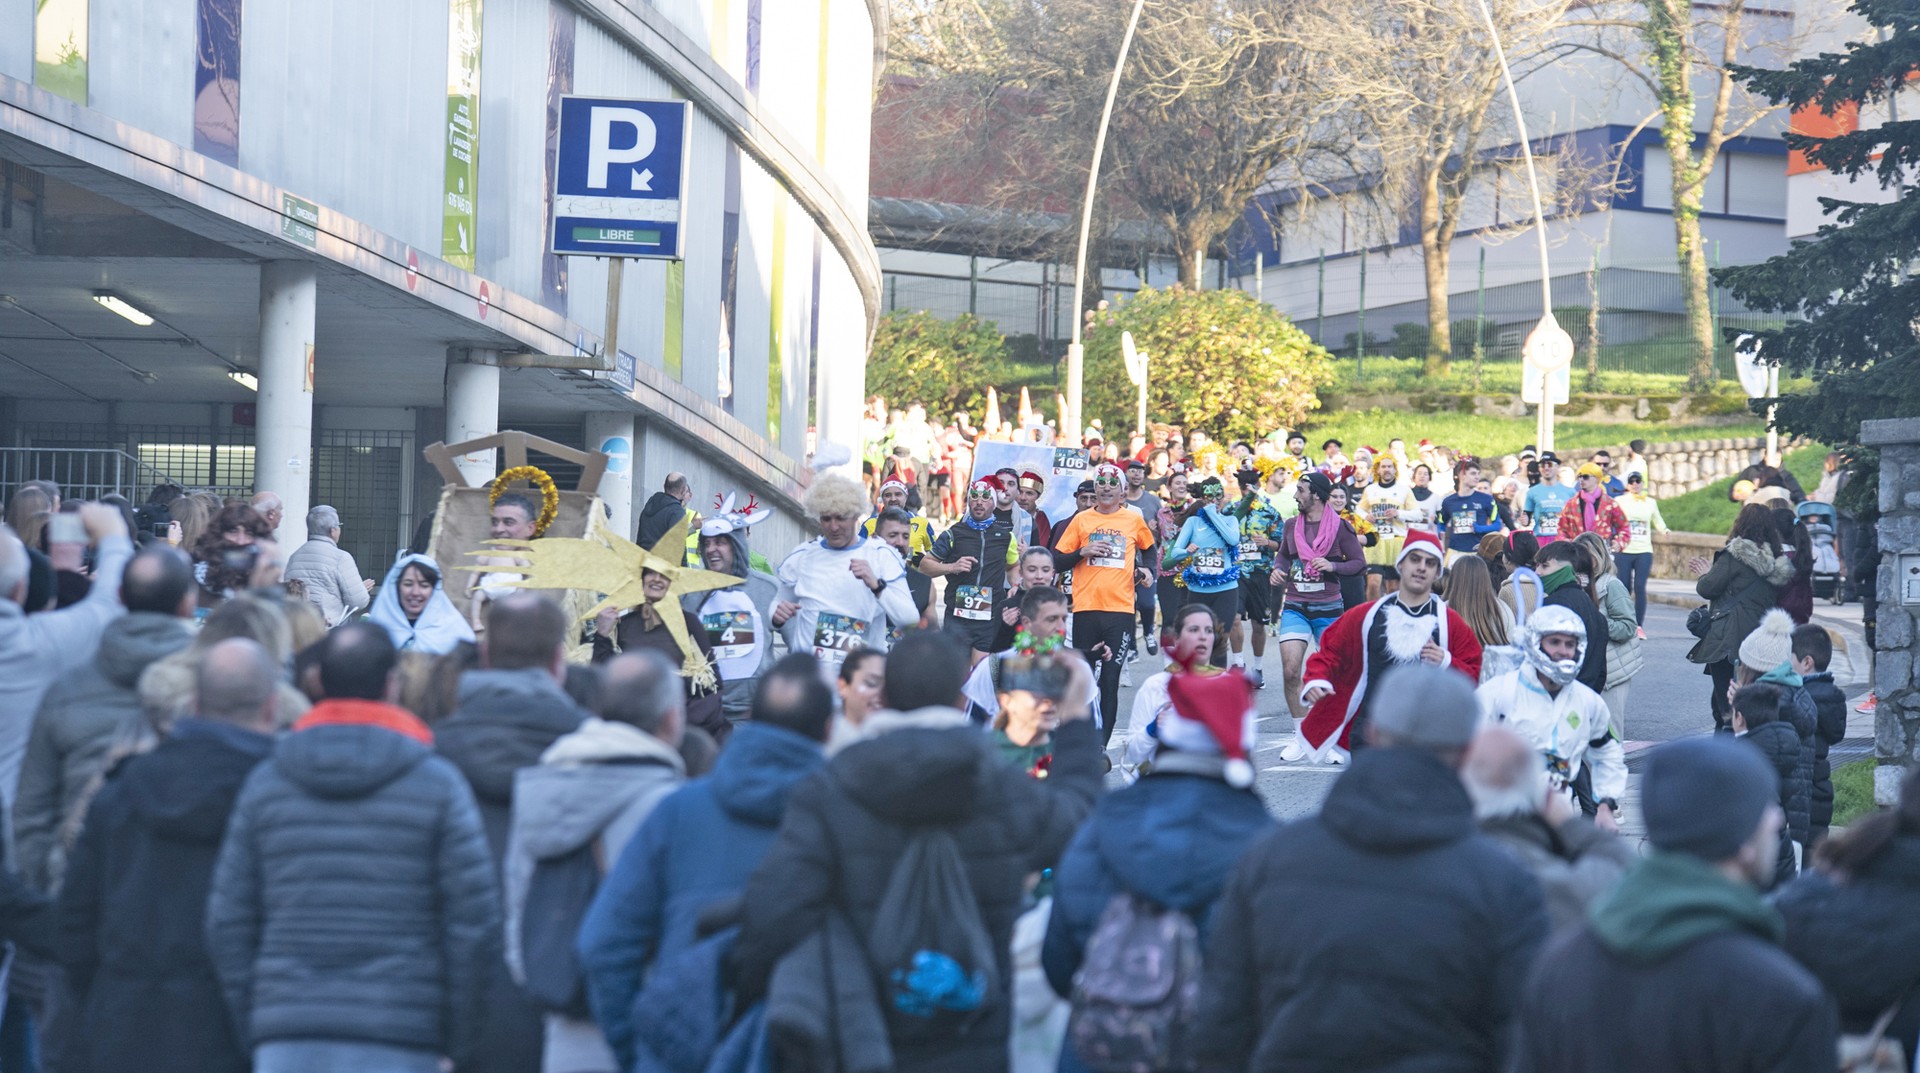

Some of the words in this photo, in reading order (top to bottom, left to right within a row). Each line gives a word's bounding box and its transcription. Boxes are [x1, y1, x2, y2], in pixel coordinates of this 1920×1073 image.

[587, 106, 657, 189] P
[600, 229, 634, 241] LIBRE
[1058, 457, 1084, 469] 106
[1198, 555, 1222, 567] 385
[964, 596, 984, 609] 97
[721, 627, 736, 643] 4
[820, 629, 862, 650] 376
[1115, 631, 1131, 665] NIKE
